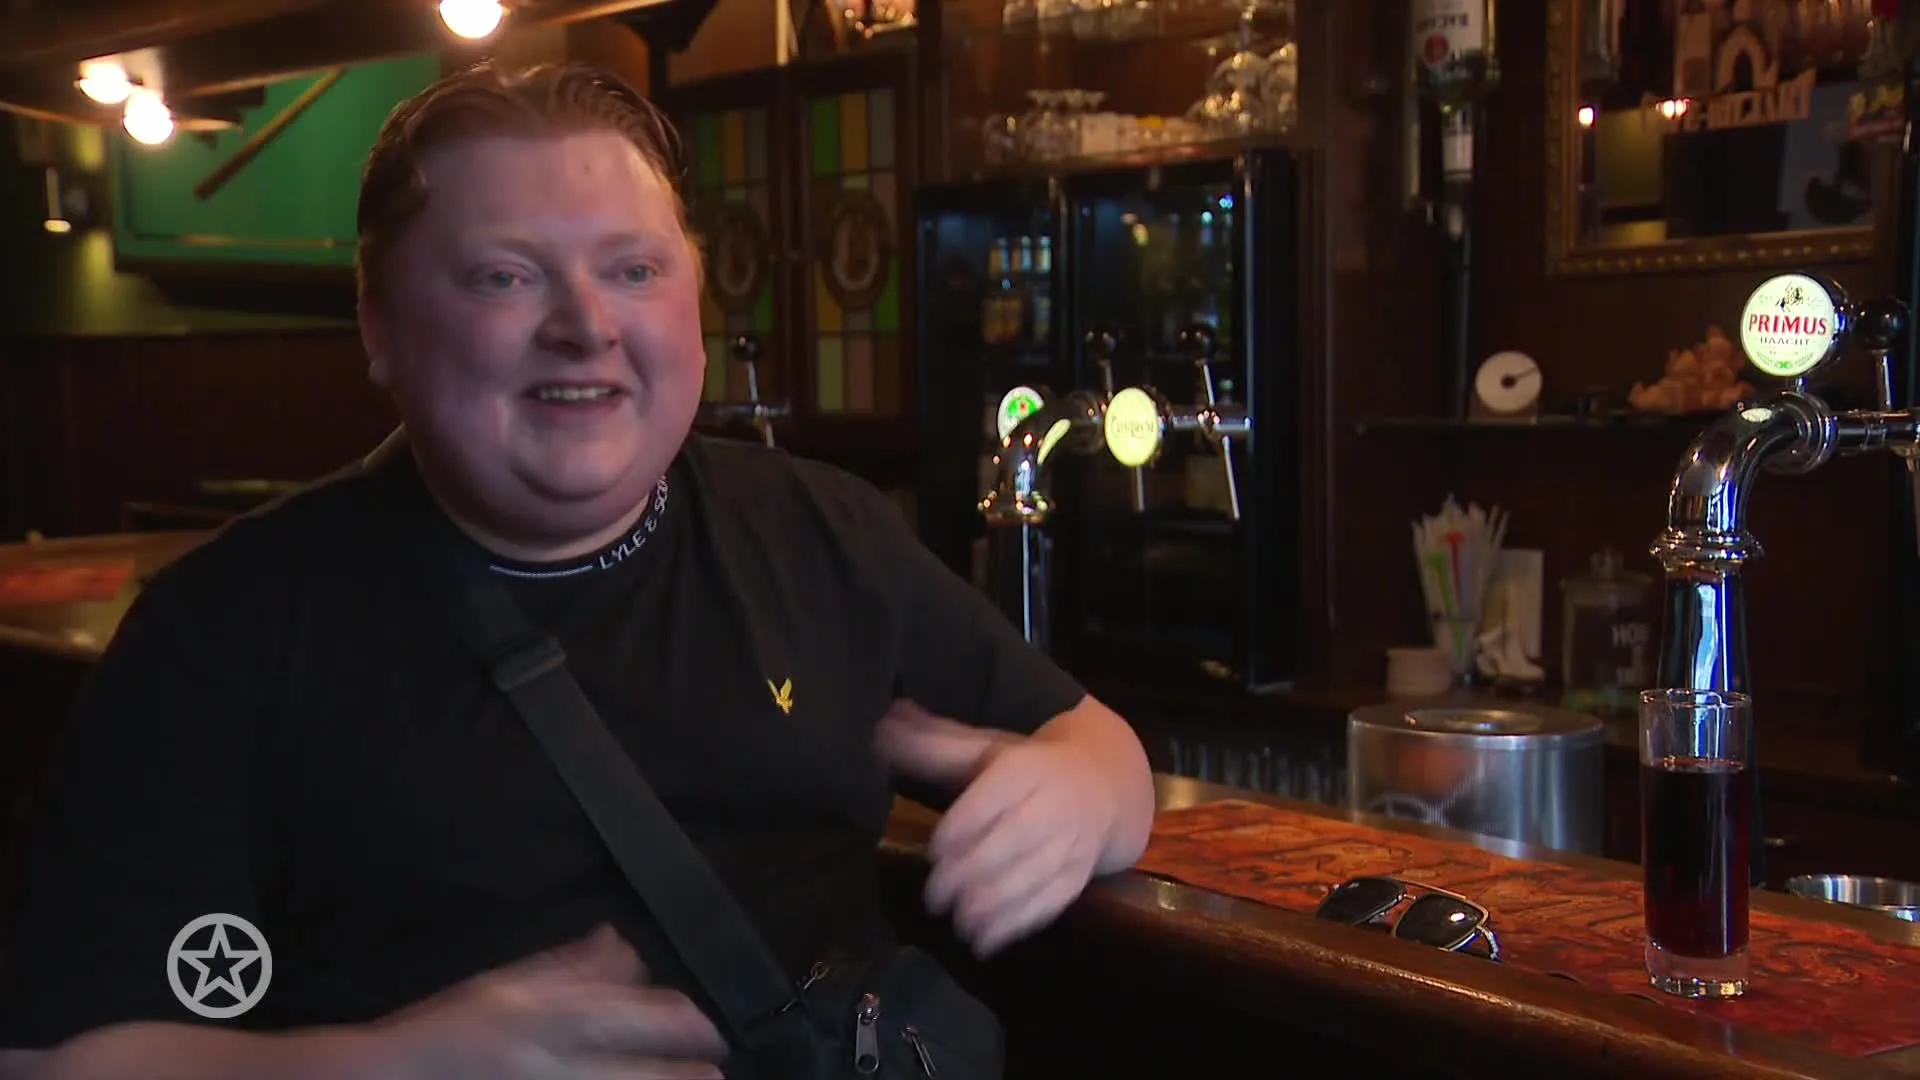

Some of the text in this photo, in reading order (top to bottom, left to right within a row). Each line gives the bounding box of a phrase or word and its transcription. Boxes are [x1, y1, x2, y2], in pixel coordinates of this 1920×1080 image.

[1748, 313, 1828, 336] PRIMUS
[1760, 335, 1811, 347] HAACHT
[599, 529, 646, 570] LYLE
